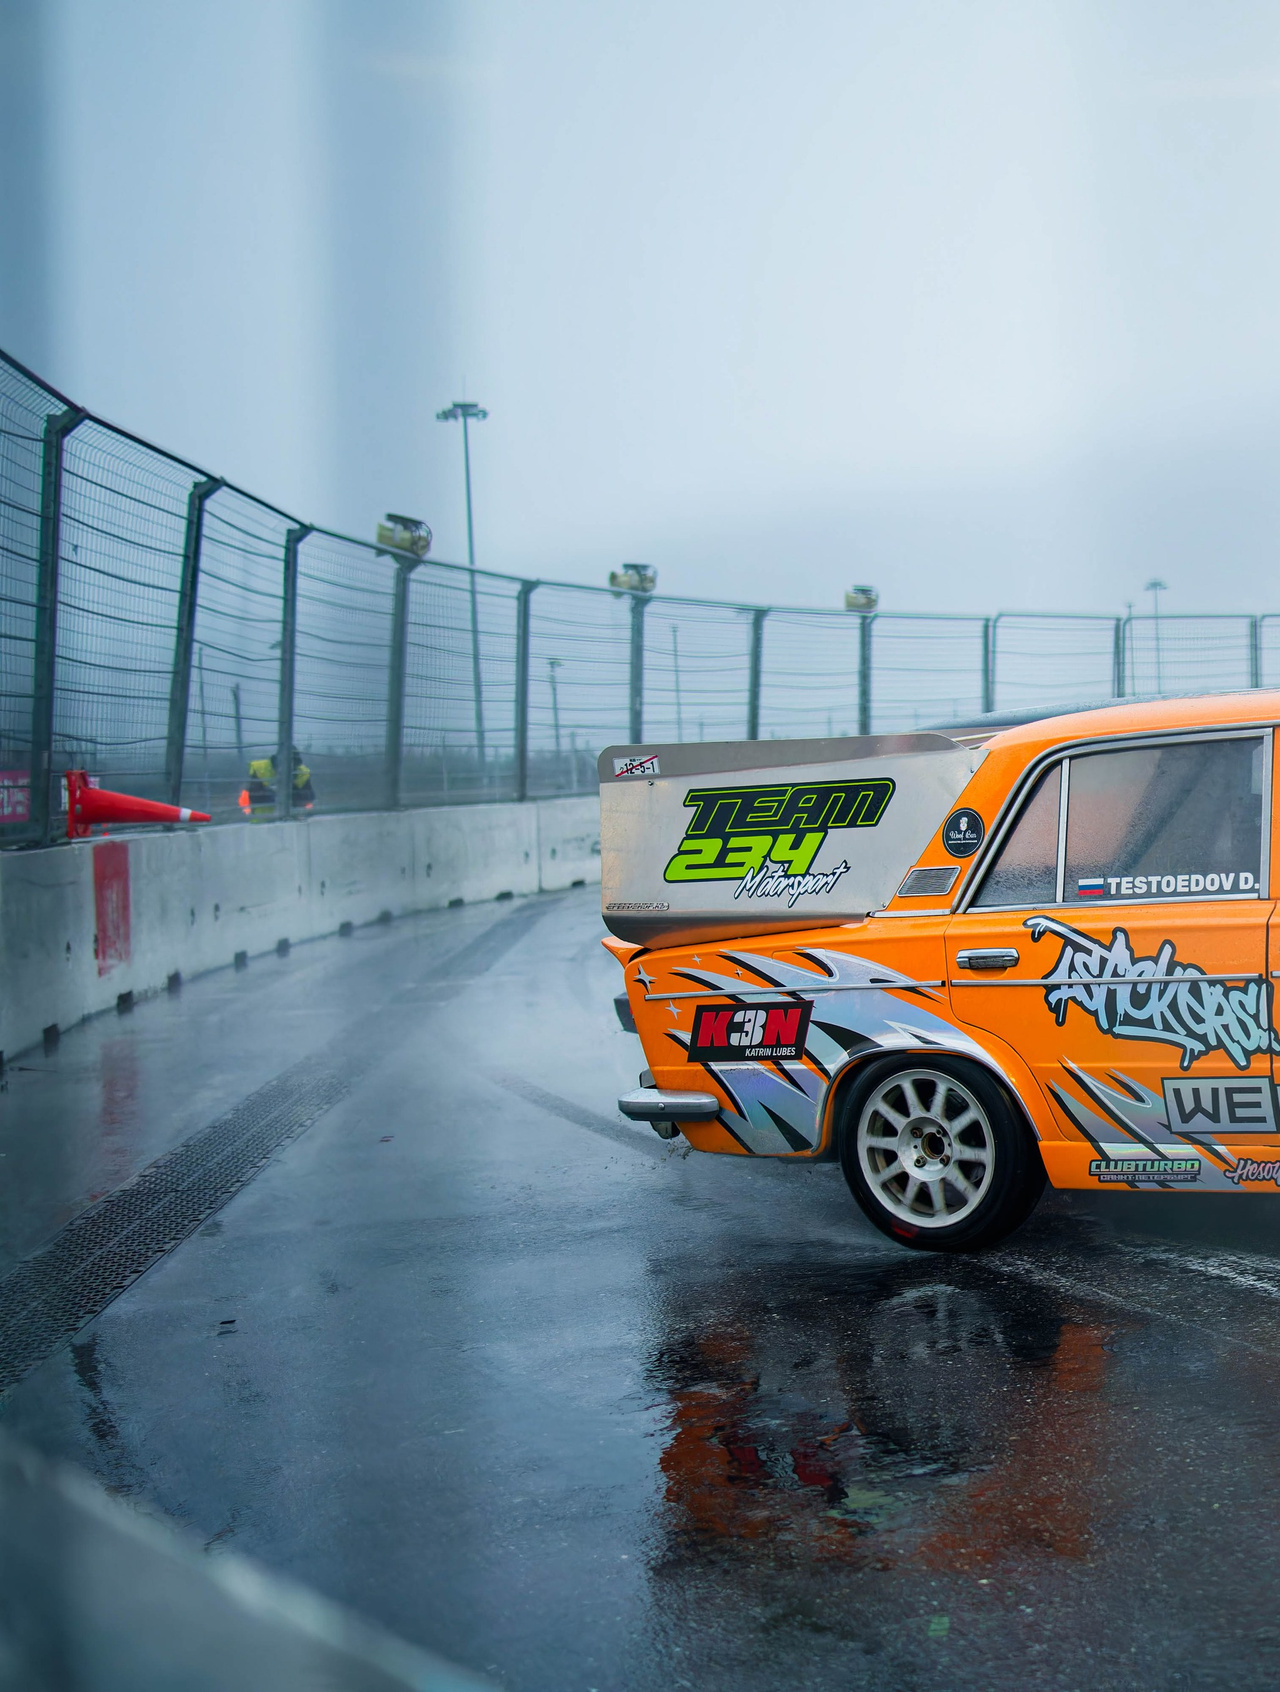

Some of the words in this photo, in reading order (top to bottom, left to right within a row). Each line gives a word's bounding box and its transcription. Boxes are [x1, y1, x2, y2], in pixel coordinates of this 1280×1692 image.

[683, 777, 896, 835] TEAM
[665, 831, 828, 883] 234
[734, 859, 851, 908] Motorsport
[1107, 873, 1236, 895] TESTOEDOV
[1239, 872, 1260, 891] D.
[697, 1008, 802, 1047] K3N
[745, 1048, 771, 1057] KATRIN
[772, 1047, 796, 1057] LUBES
[1171, 1086, 1268, 1124] WE
[1090, 1160, 1200, 1172] CLUBTURBO
